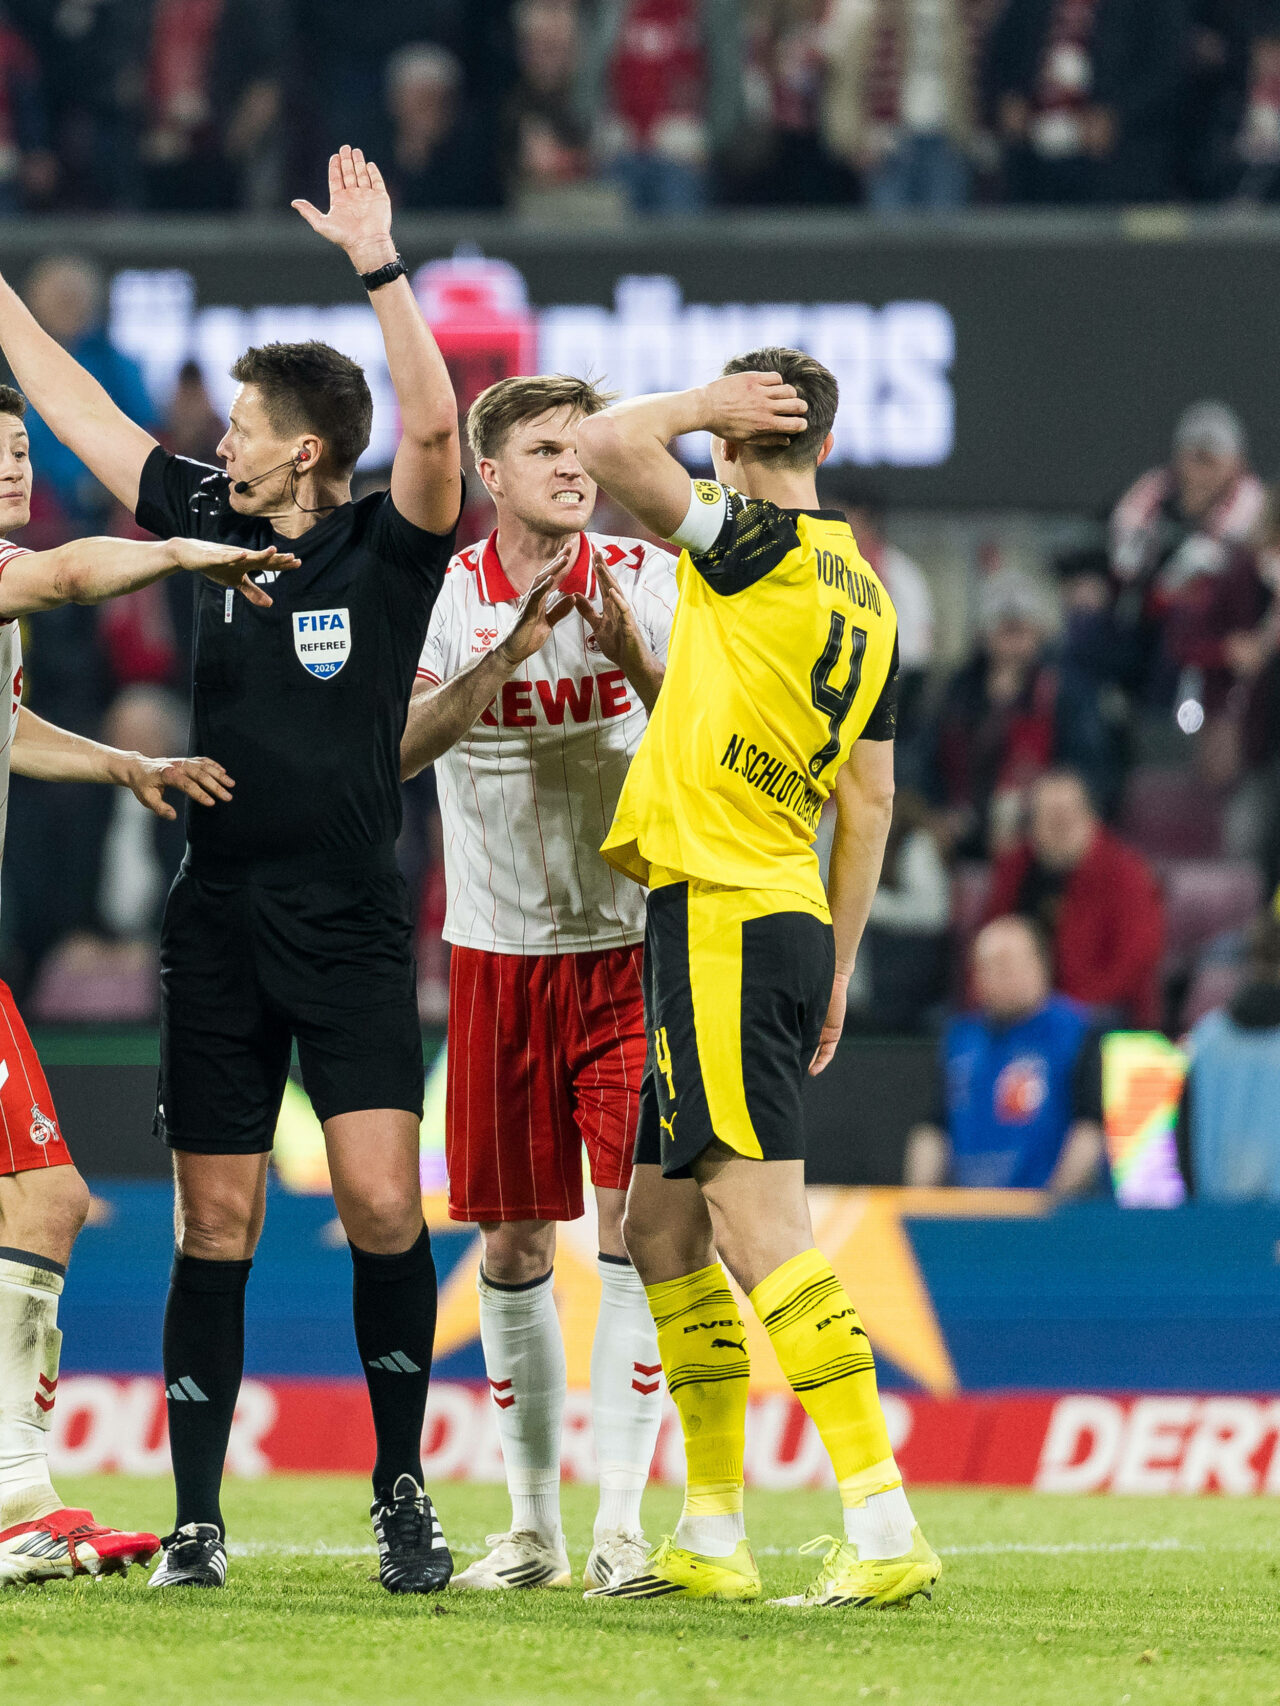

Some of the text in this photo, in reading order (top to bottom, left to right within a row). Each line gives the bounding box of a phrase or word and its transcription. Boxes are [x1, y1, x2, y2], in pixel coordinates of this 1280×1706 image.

[298, 614, 345, 632] FIFA
[300, 640, 346, 652] REFEREE
[314, 663, 336, 673] 2026
[809, 610, 868, 781] 4
[654, 1026, 676, 1100] 4
[684, 1319, 733, 1334] BVB
[815, 1308, 856, 1331] BVB
[1032, 1394, 1280, 1495] DER
